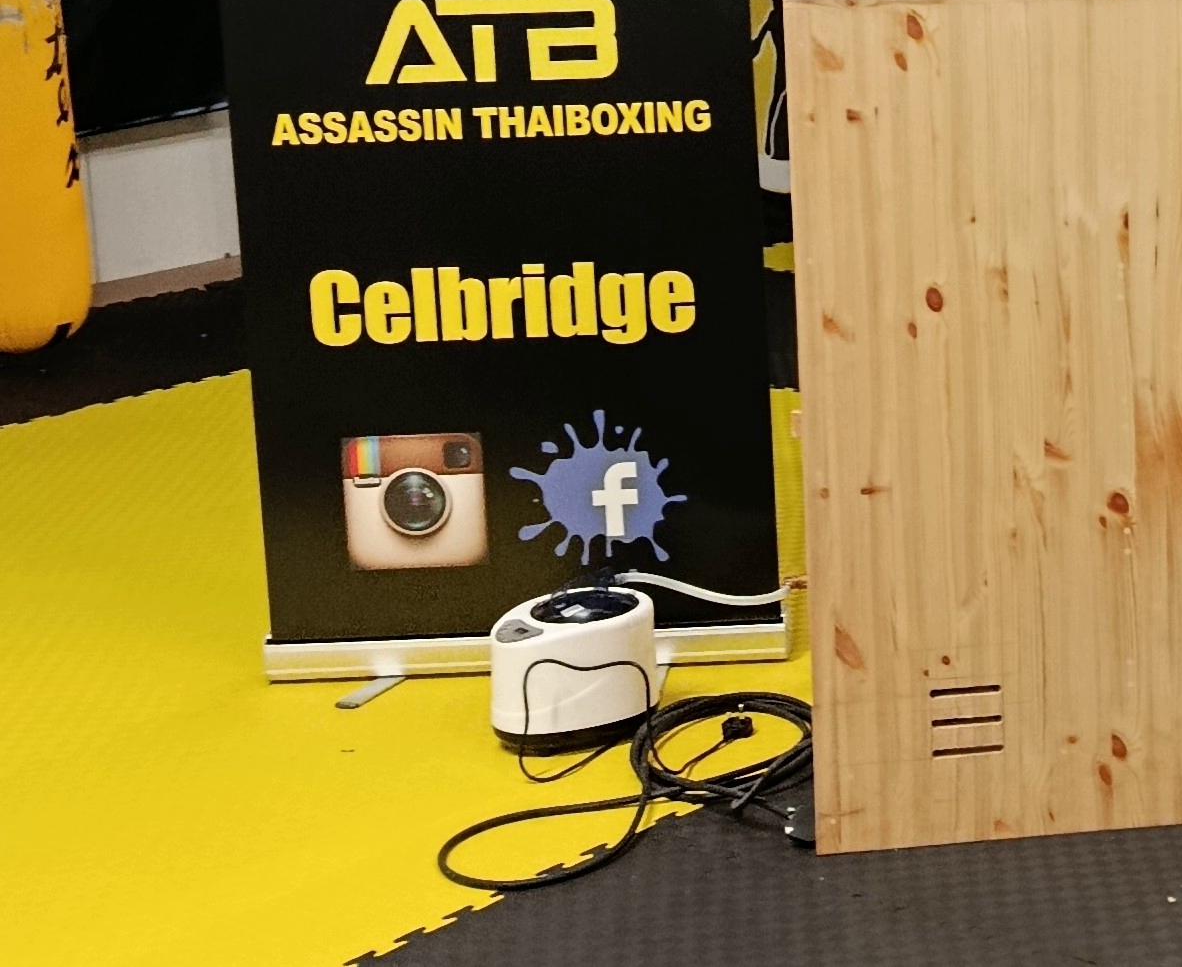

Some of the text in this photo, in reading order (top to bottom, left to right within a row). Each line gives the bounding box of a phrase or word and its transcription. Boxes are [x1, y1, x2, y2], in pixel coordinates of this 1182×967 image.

[271, 98, 713, 147] ASSASSIN THAIBOXING
[309, 260, 697, 348] Celbridge
